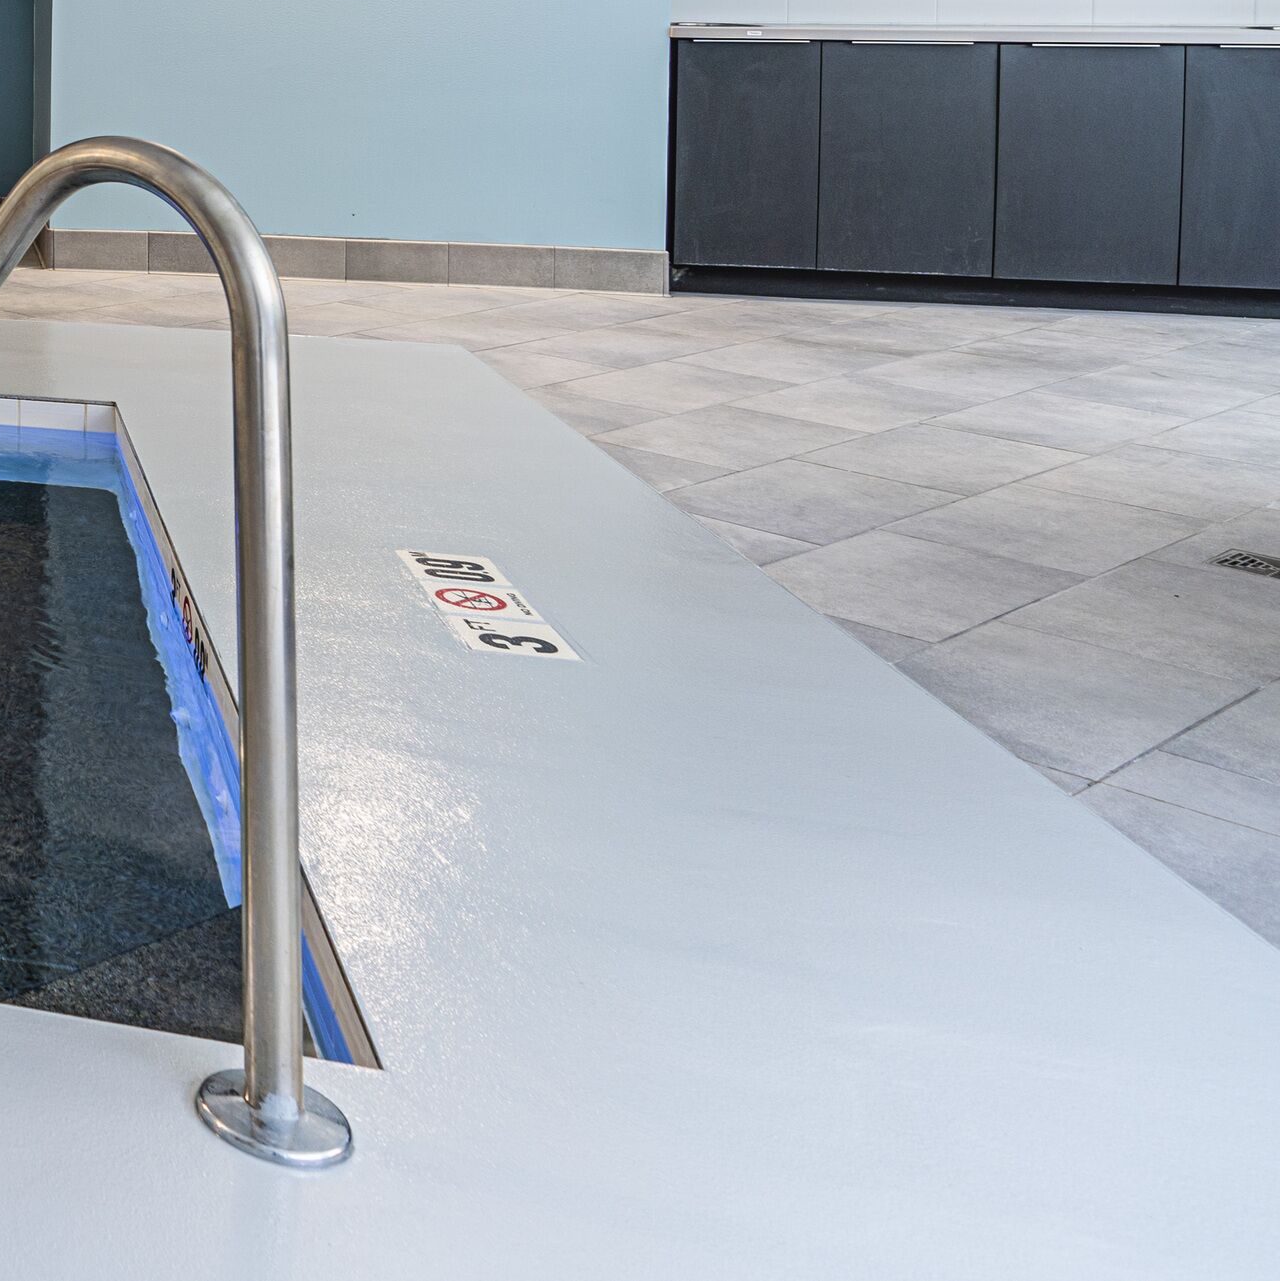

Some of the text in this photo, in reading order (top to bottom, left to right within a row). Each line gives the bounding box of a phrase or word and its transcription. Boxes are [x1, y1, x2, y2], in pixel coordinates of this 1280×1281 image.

[415, 557, 495, 582] 0.9
[462, 618, 559, 653] 3 FT
